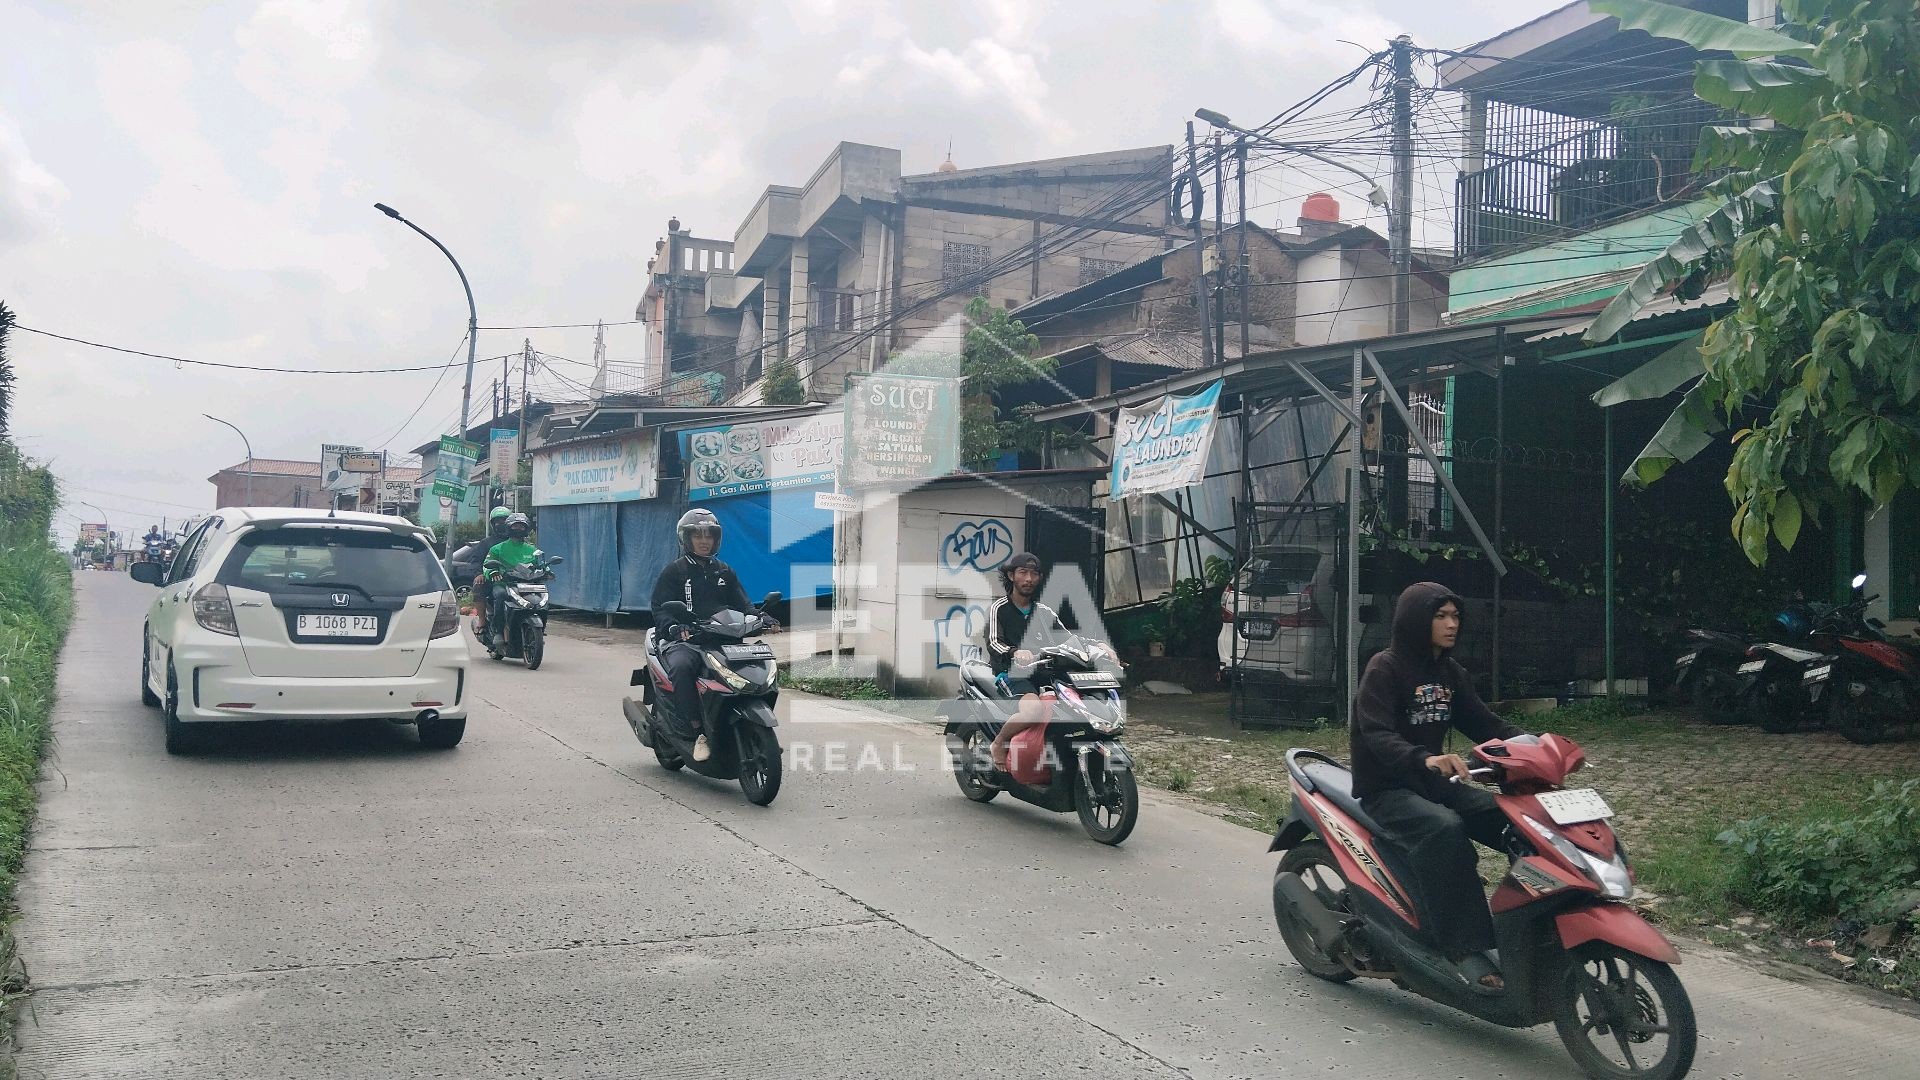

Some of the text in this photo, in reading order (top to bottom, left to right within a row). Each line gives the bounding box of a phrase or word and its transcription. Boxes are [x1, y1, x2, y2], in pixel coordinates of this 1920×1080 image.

[870, 384, 934, 410] SUCI
[1119, 400, 1174, 446] SUCI
[877, 443, 923, 453] SATUAN
[1134, 432, 1204, 465] LAUNDRY
[720, 485, 737, 494] Gas
[739, 482, 764, 492] Alam
[765, 475, 812, 488] Pertamina
[299, 615, 376, 630] B 1068 PZI
